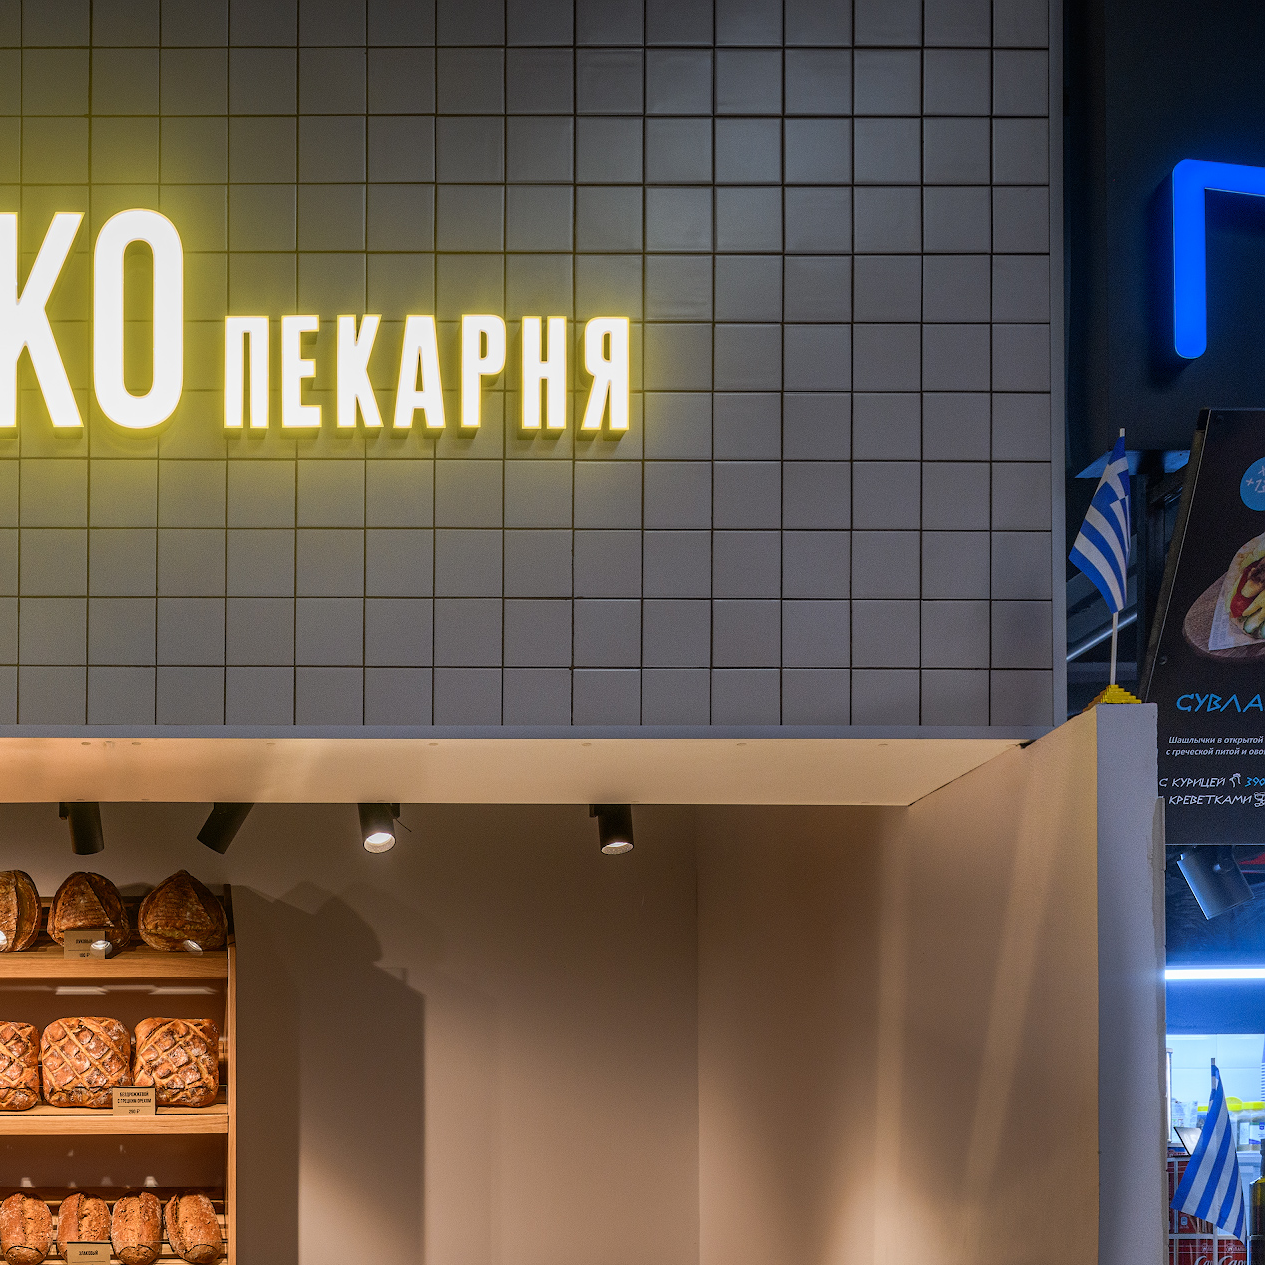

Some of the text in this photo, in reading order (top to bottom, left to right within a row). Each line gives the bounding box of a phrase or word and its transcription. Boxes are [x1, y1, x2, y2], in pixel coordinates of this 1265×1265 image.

[223, 314, 632, 432] ПЕКАРНЯ
[1168, 736, 1215, 744] Шашлычки
[1224, 736, 1264, 747] открытой
[1172, 748, 1213, 757] греческой
[1215, 748, 1240, 756] питой
[1172, 777, 1226, 788] КУРИЦЕЙ
[1169, 795, 1253, 805] КРЕВЕТКАМИ
